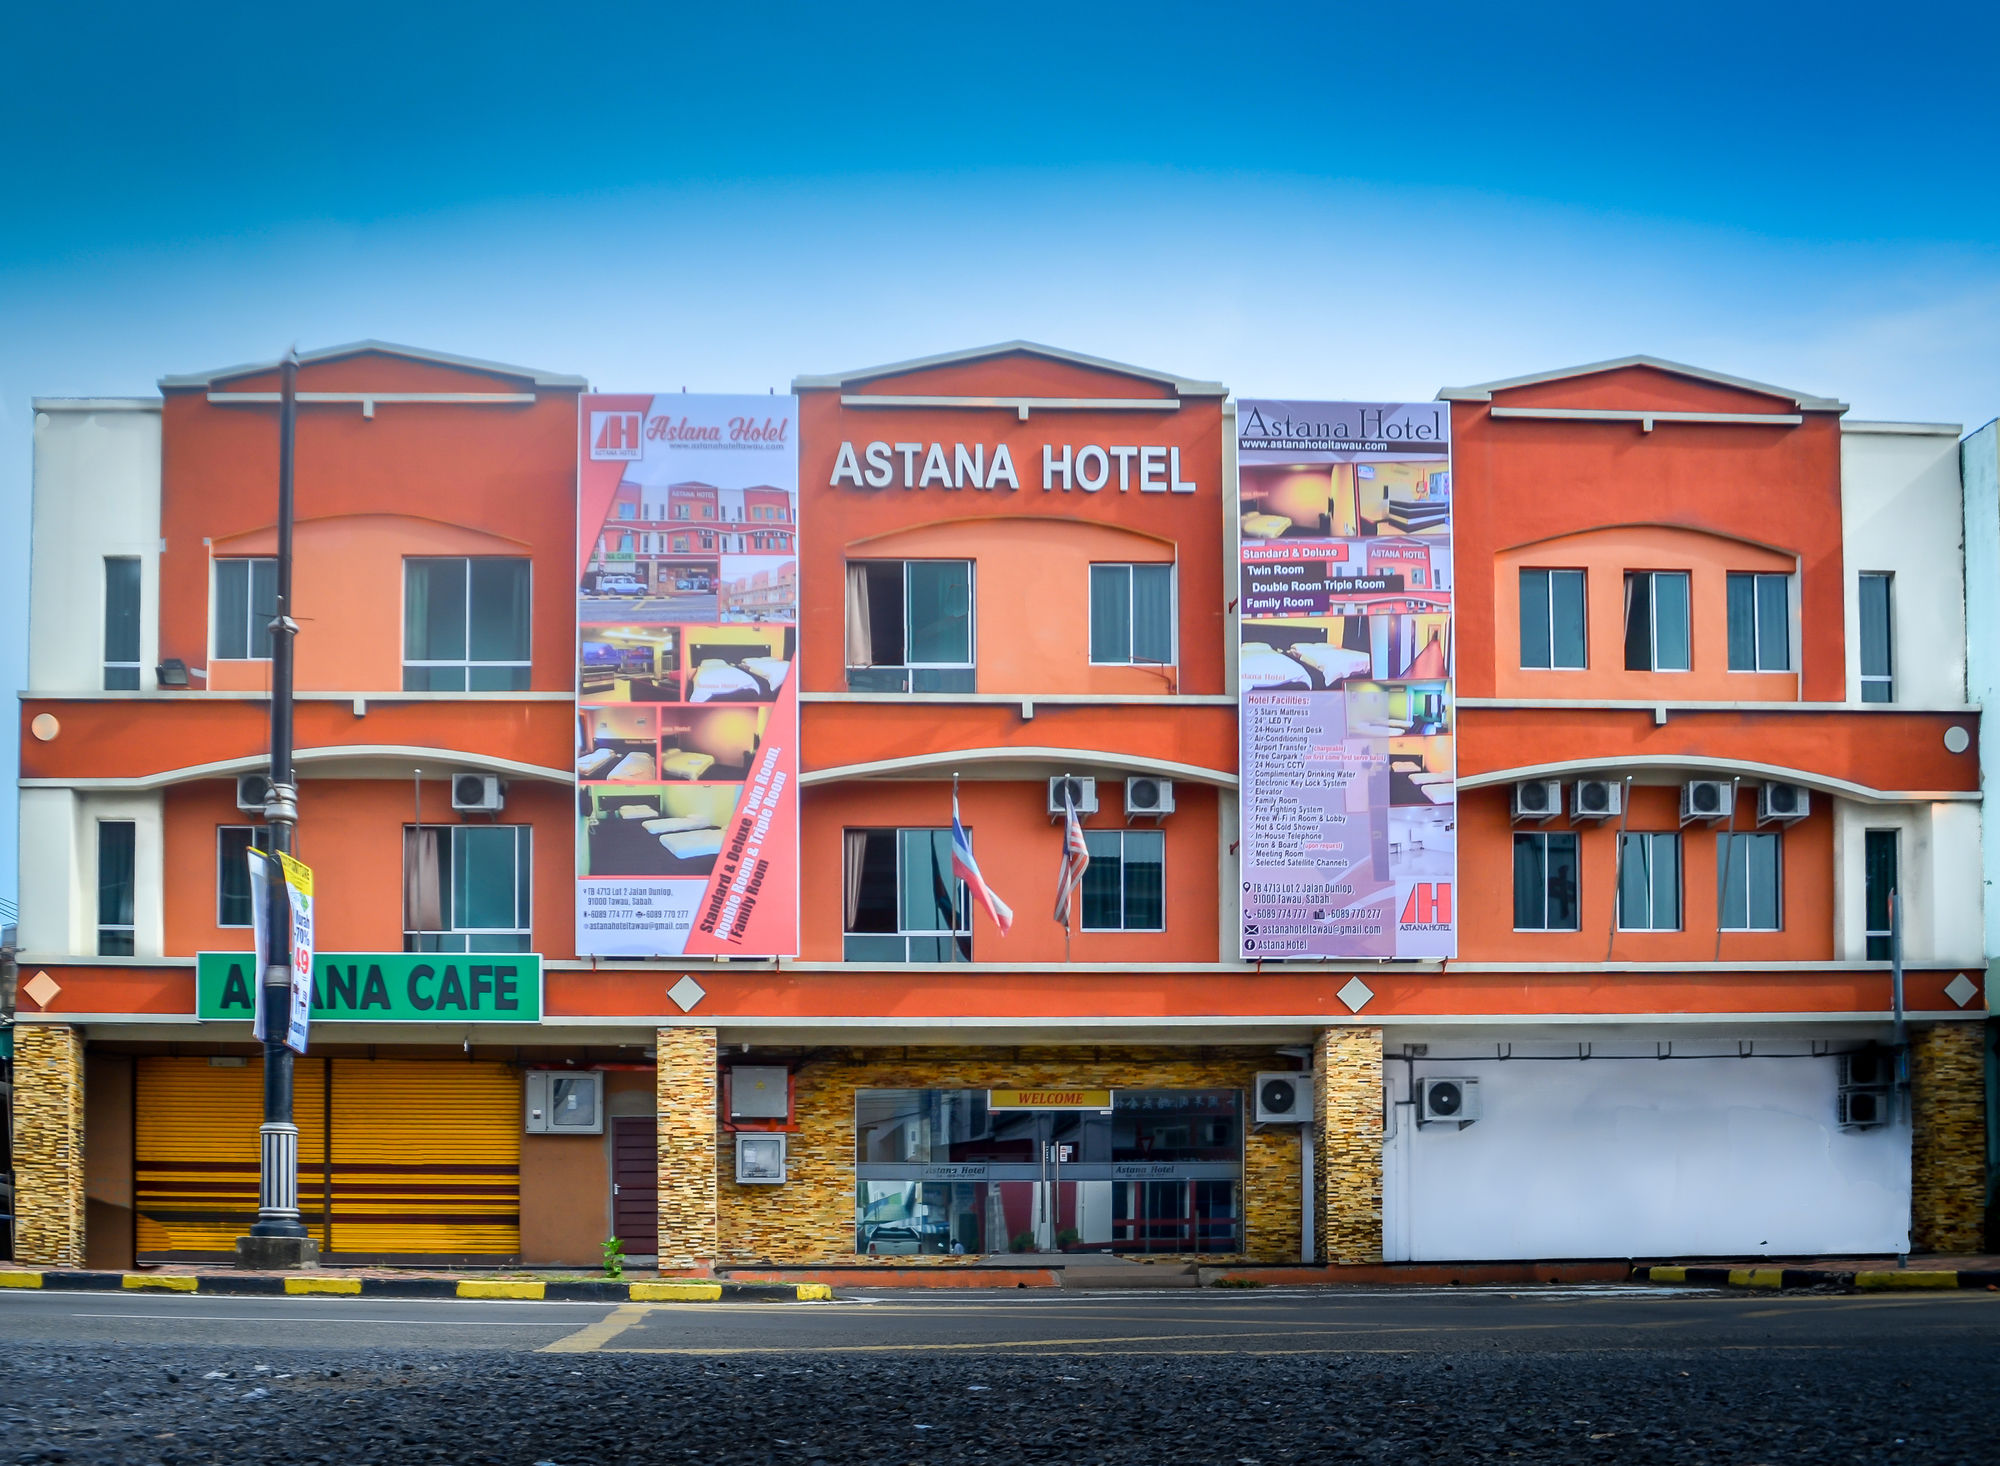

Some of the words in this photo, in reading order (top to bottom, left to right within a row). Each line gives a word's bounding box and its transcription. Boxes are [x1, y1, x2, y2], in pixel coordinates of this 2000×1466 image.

[646, 415, 722, 441] Astana
[728, 416, 788, 442] Hotel
[1242, 406, 1350, 438] Astana
[1358, 408, 1442, 440] Hotel
[1242, 439, 1388, 451] www.astanahoteltawau.com
[829, 441, 1019, 490] ASTANA
[1042, 444, 1196, 493] HOTEL
[1243, 548, 1289, 559] Standard
[1292, 549, 1300, 558] &
[1302, 548, 1338, 558] Deluxe
[1371, 550, 1400, 558] ASTANA
[1402, 551, 1426, 559] HOTEL
[1247, 566, 1271, 575] Twin
[1274, 565, 1304, 575] Room
[1253, 582, 1288, 592] Double
[1291, 581, 1322, 591] Room
[1324, 580, 1352, 591] Triple
[1355, 579, 1385, 589] Room
[1246, 598, 1280, 609] Family
[1283, 598, 1314, 607] Room
[1248, 696, 1269, 704] Hotel
[1271, 696, 1310, 704] Facilities:
[1255, 744, 1277, 752] Airport
[1271, 753, 1297, 761] Carpark
[754, 746, 782, 786] Room,
[1255, 771, 1305, 779] Complimentary
[1308, 771, 1335, 779] Drinking
[763, 770, 787, 808] Room
[1291, 780, 1303, 788] Key
[1323, 780, 1347, 788] System
[742, 787, 766, 816] Twin
[1256, 797, 1276, 806] Family
[1270, 806, 1297, 814] Fighting
[1299, 806, 1323, 814] System
[1326, 815, 1346, 823] Lobby
[748, 807, 774, 845] Triple
[726, 818, 753, 862] Deluxe
[747, 847, 759, 858] &
[1256, 850, 1282, 858] Meeting
[724, 864, 735, 874] &
[731, 857, 755, 894] Room
[1254, 884, 1261, 893] TB
[1264, 884, 1280, 893] 4713
[1283, 884, 1294, 893] Lot
[1296, 884, 1300, 893] 2
[1302, 884, 1323, 893] Jalan
[1326, 884, 1356, 894] Dunlop,
[700, 874, 731, 933] Standard
[730, 895, 757, 939] Family
[745, 859, 769, 896] Room
[1254, 895, 1276, 903] 91000
[1278, 895, 1304, 904] Tawau,
[714, 894, 742, 940] Double
[1278, 909, 1291, 918] 774
[1294, 909, 1307, 918] 777
[1352, 909, 1365, 918] 770
[1368, 909, 1381, 918] 277
[1263, 925, 1381, 936] astanahoteltawau@gmail.com
[1258, 940, 1285, 950] Astana
[1287, 940, 1307, 950] Hotel
[220, 963, 392, 1010] ANA
[407, 964, 519, 1011] CAFE
[1018, 1092, 1084, 1104] WELCOME
[962, 1166, 986, 1174] Hotel
